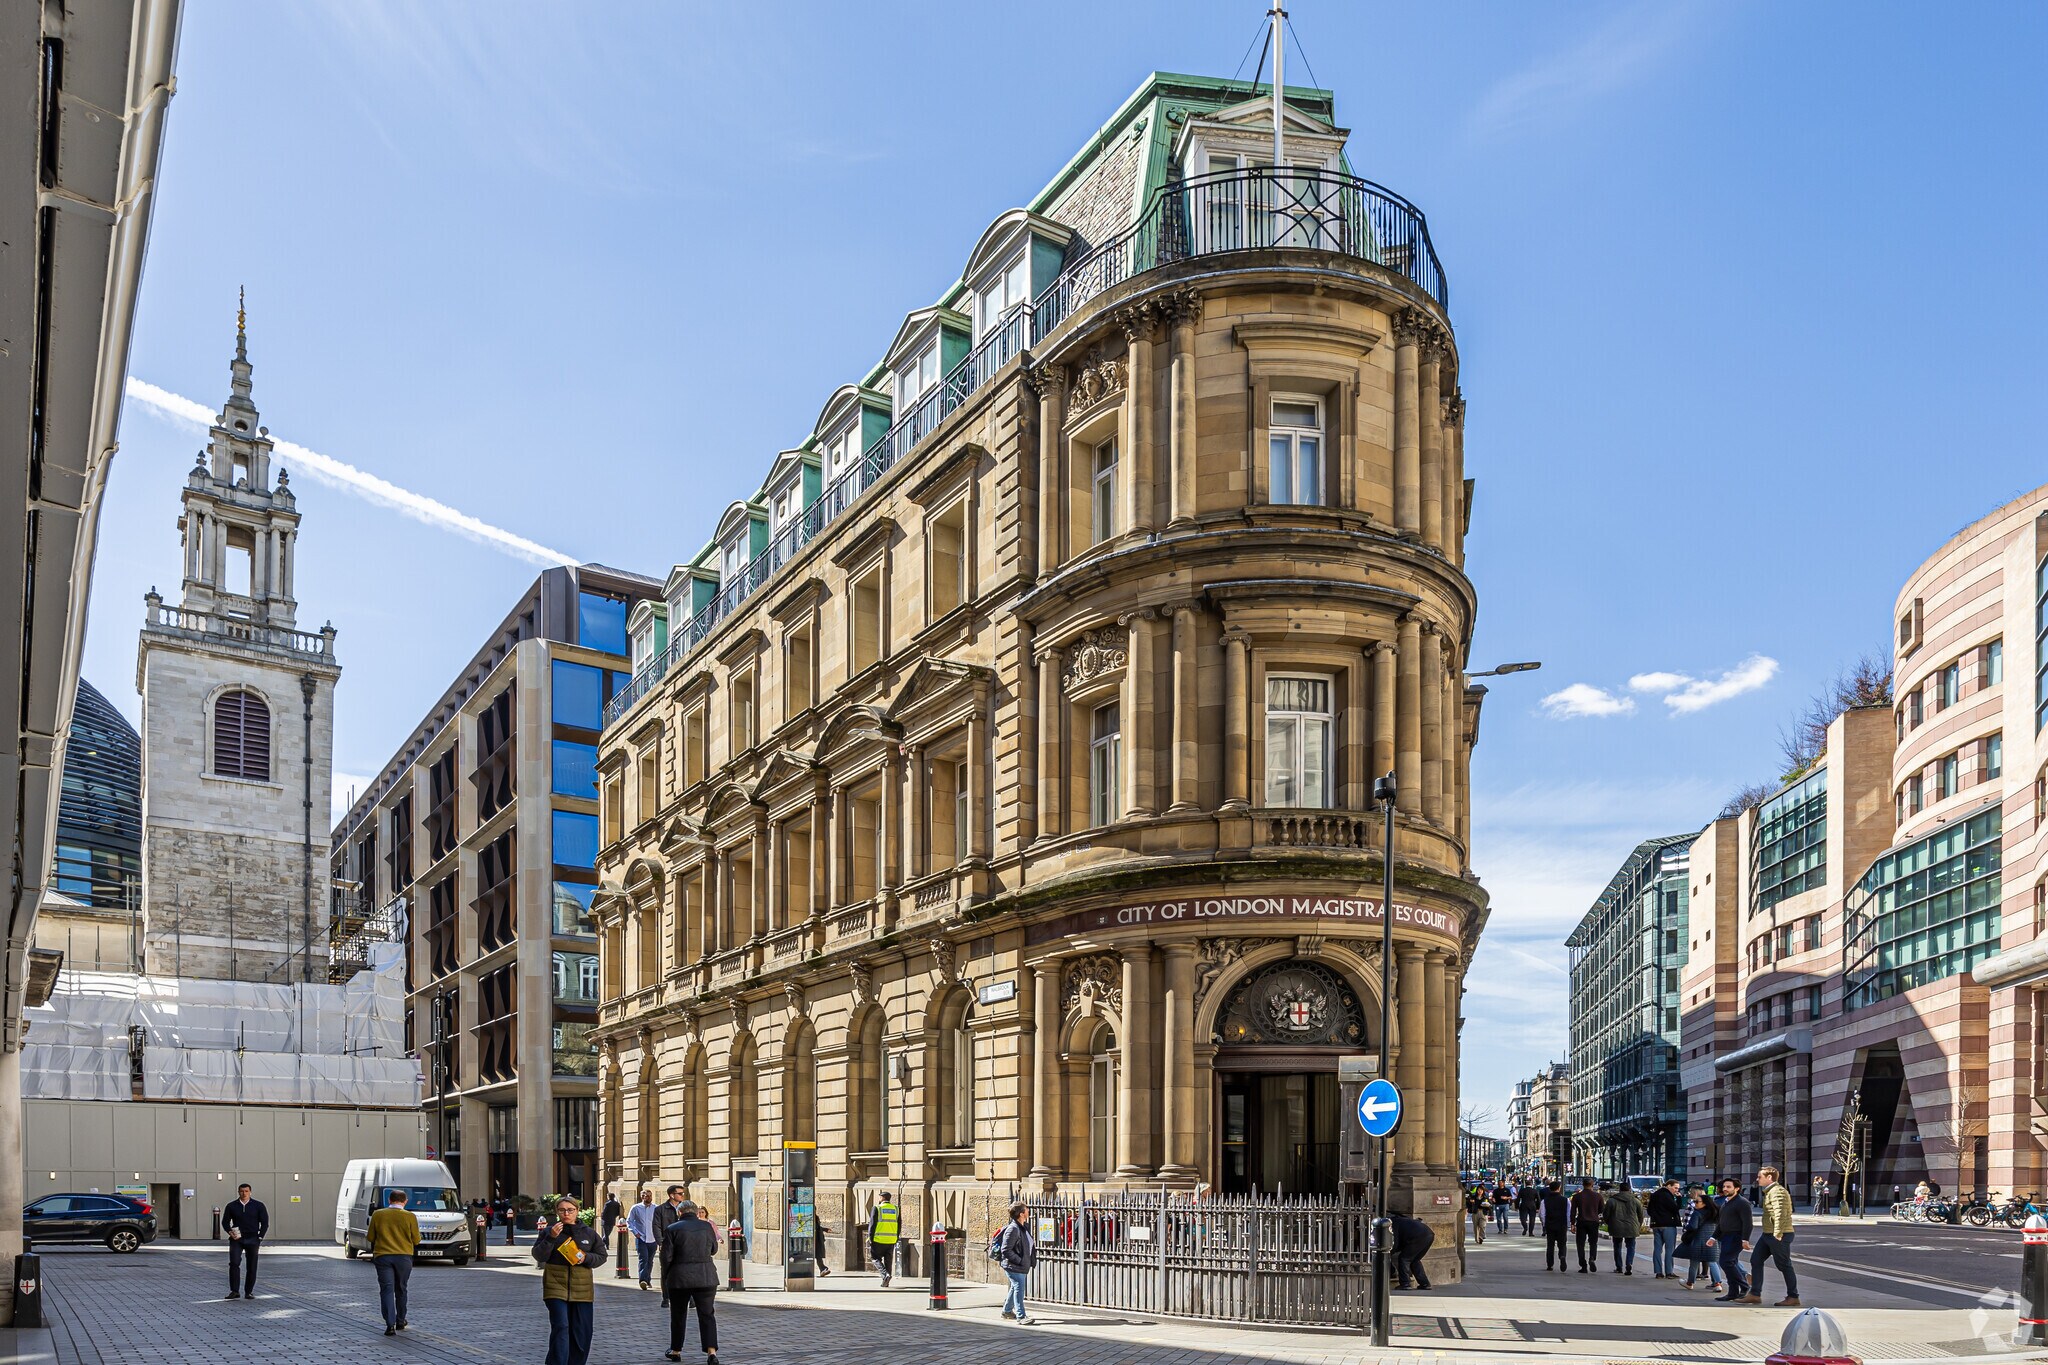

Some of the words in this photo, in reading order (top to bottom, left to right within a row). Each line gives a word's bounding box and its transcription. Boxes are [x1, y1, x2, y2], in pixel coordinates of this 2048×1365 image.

[1117, 905, 1156, 923] CITY
[1161, 902, 1187, 919] OF
[1195, 898, 1284, 917] LONDON
[1292, 898, 1413, 922] MAGISTRAES'
[1414, 908, 1447, 930] COURT
